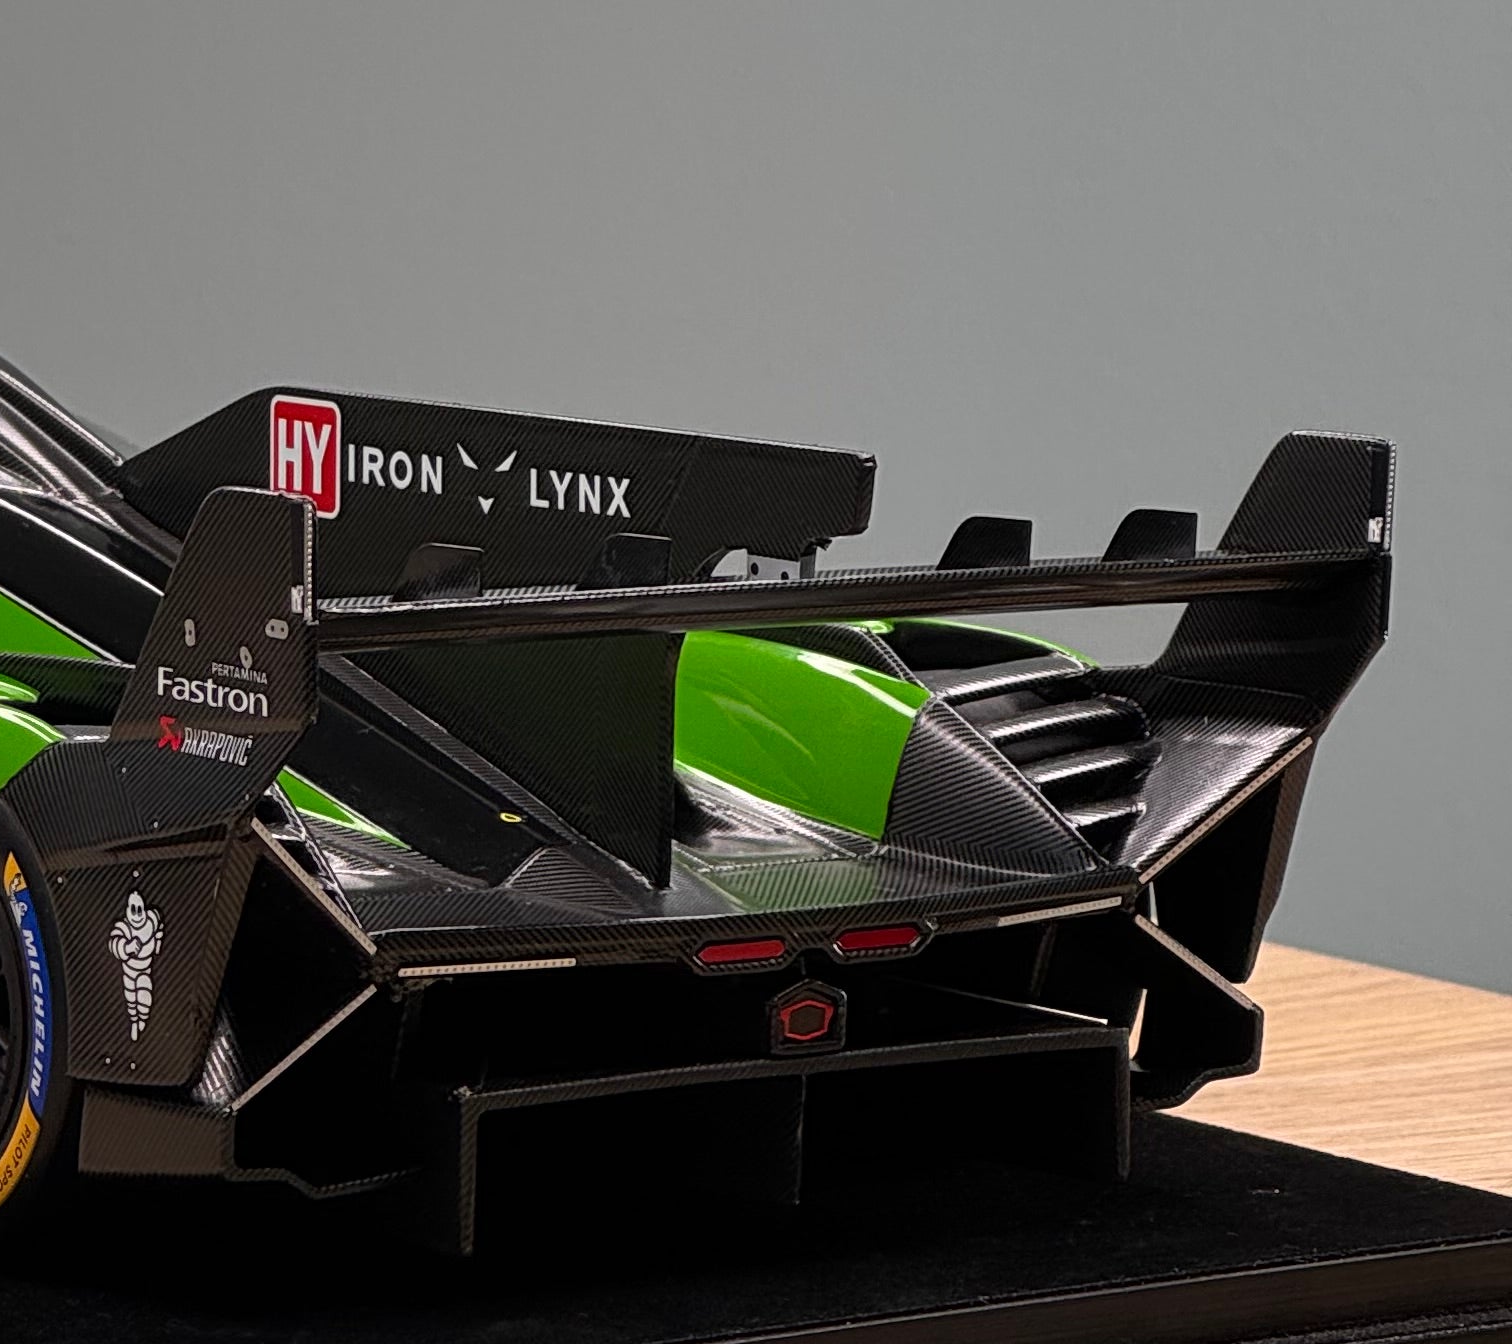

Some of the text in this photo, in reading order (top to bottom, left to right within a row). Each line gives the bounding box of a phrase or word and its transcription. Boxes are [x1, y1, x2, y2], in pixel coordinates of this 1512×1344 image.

[277, 417, 333, 495] HY
[347, 443, 632, 518] IRON LYNX
[157, 666, 268, 718] Fastron
[211, 661, 268, 685] PERTAMINA
[22, 928, 47, 1097] MICHELIN
[11, 1123, 31, 1169] PILOT
